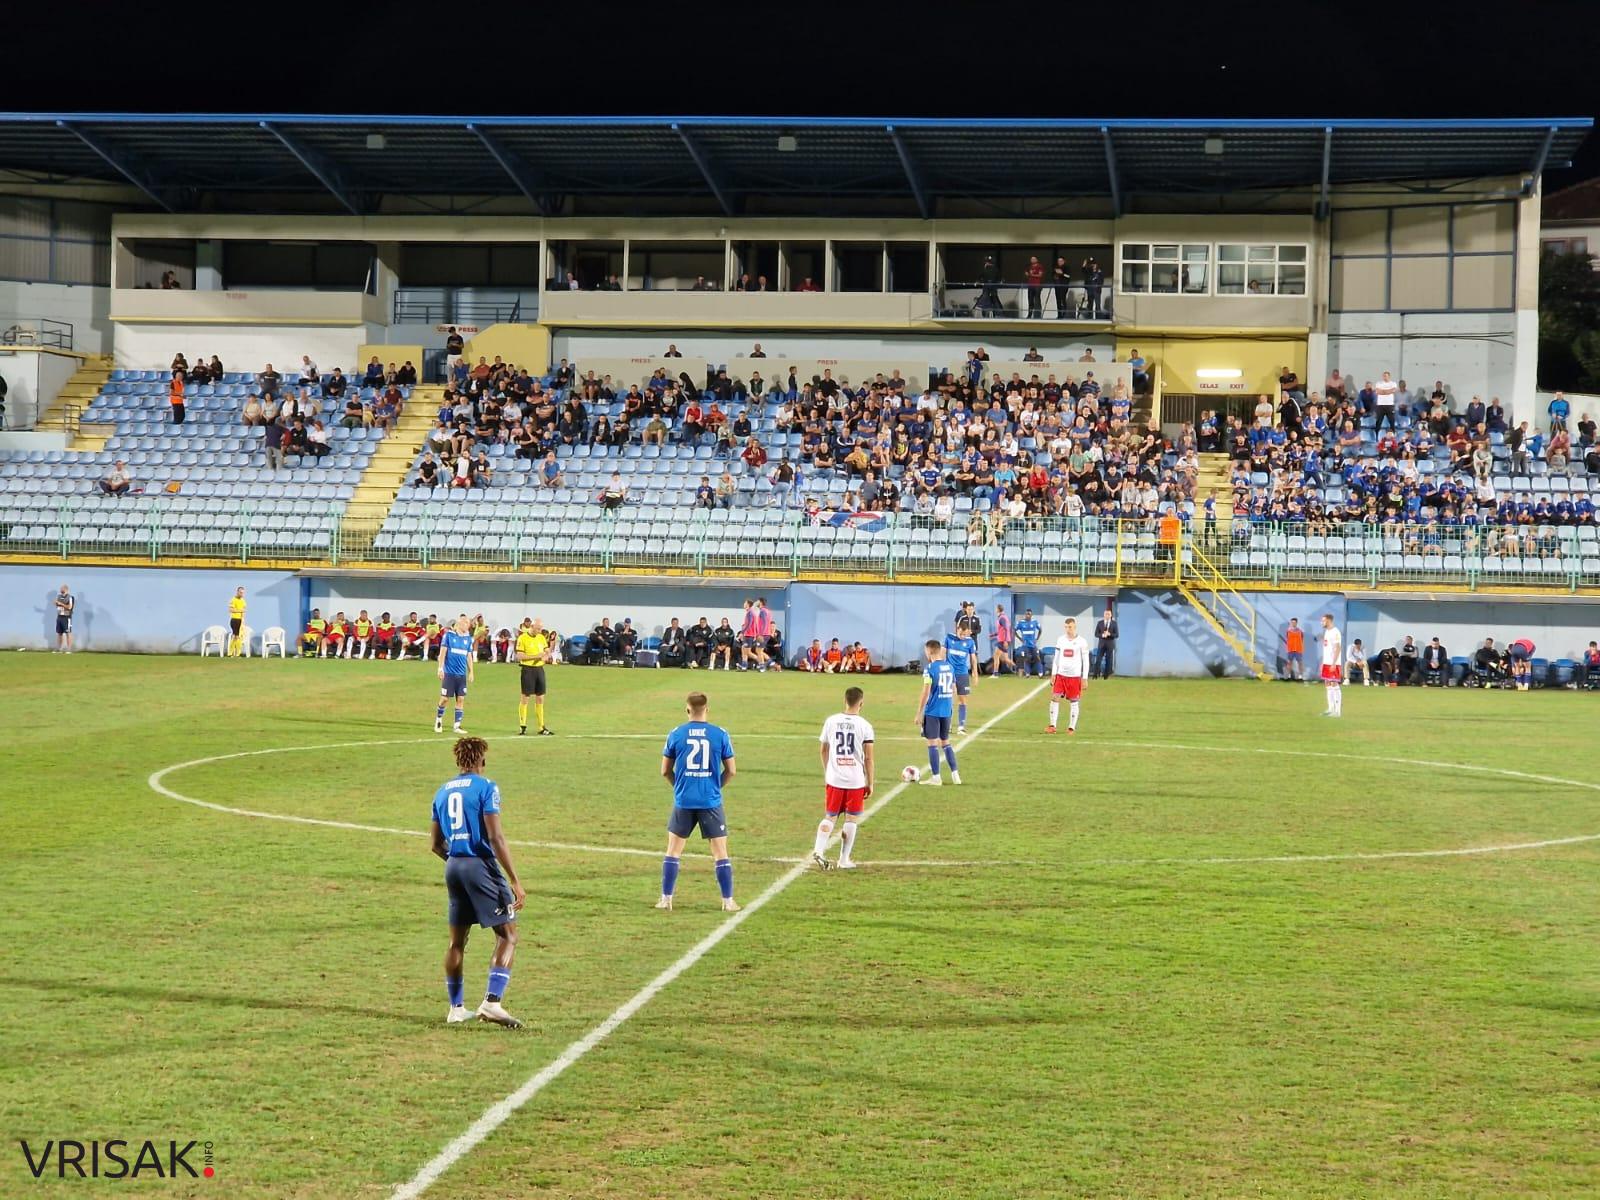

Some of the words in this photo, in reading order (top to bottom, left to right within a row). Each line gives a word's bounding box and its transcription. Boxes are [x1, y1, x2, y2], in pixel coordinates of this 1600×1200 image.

[938, 672, 953, 694] 42
[686, 738, 710, 770] 21
[835, 731, 855, 756] 29
[447, 791, 464, 830] 9
